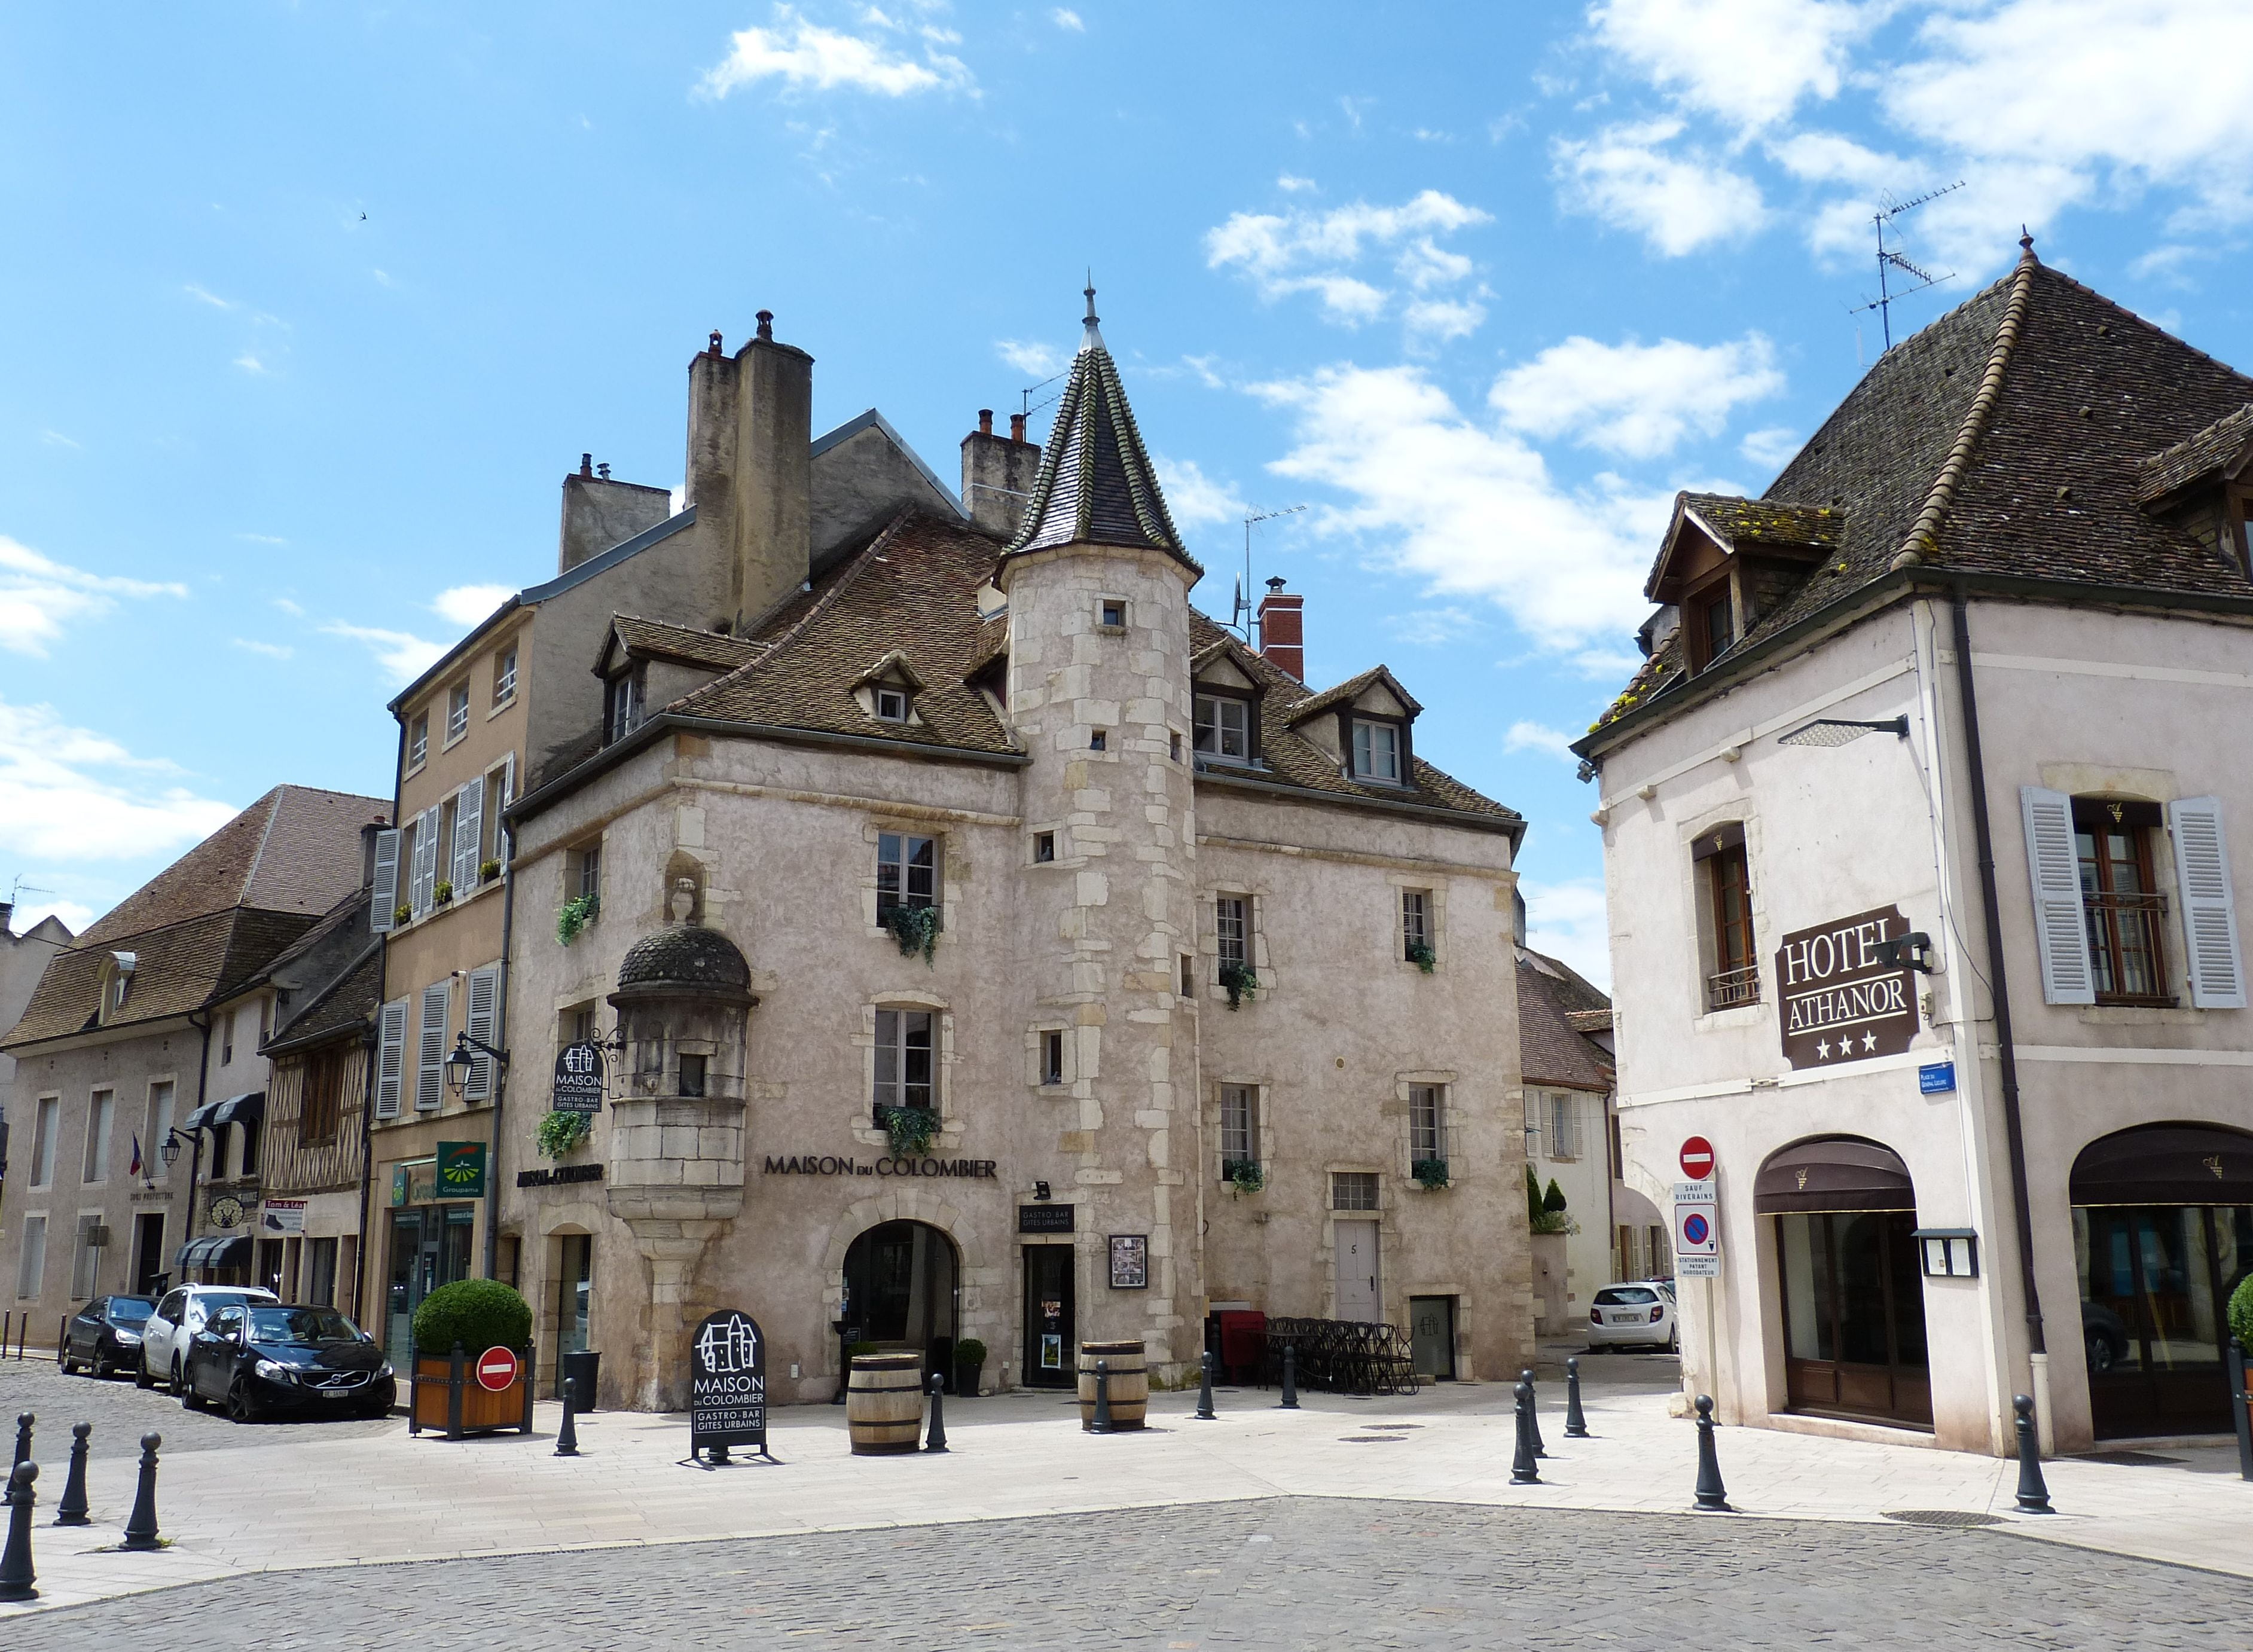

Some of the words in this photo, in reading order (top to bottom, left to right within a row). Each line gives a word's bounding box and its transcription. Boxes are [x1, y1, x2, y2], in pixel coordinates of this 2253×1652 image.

[1788, 978, 1907, 1030] ATHANOR
[555, 1074, 602, 1086] MAISON
[764, 1155, 854, 1175] MAISON
[857, 1165, 873, 1175] DU
[875, 1157, 997, 1178] COLOMBIER
[1351, 1244, 1357, 1254] 5
[694, 1376, 764, 1394] MAISON
[703, 1393, 764, 1405] COLOMBIER
[698, 1421, 722, 1430] GITES
[725, 1419, 761, 1428] URBAINS
